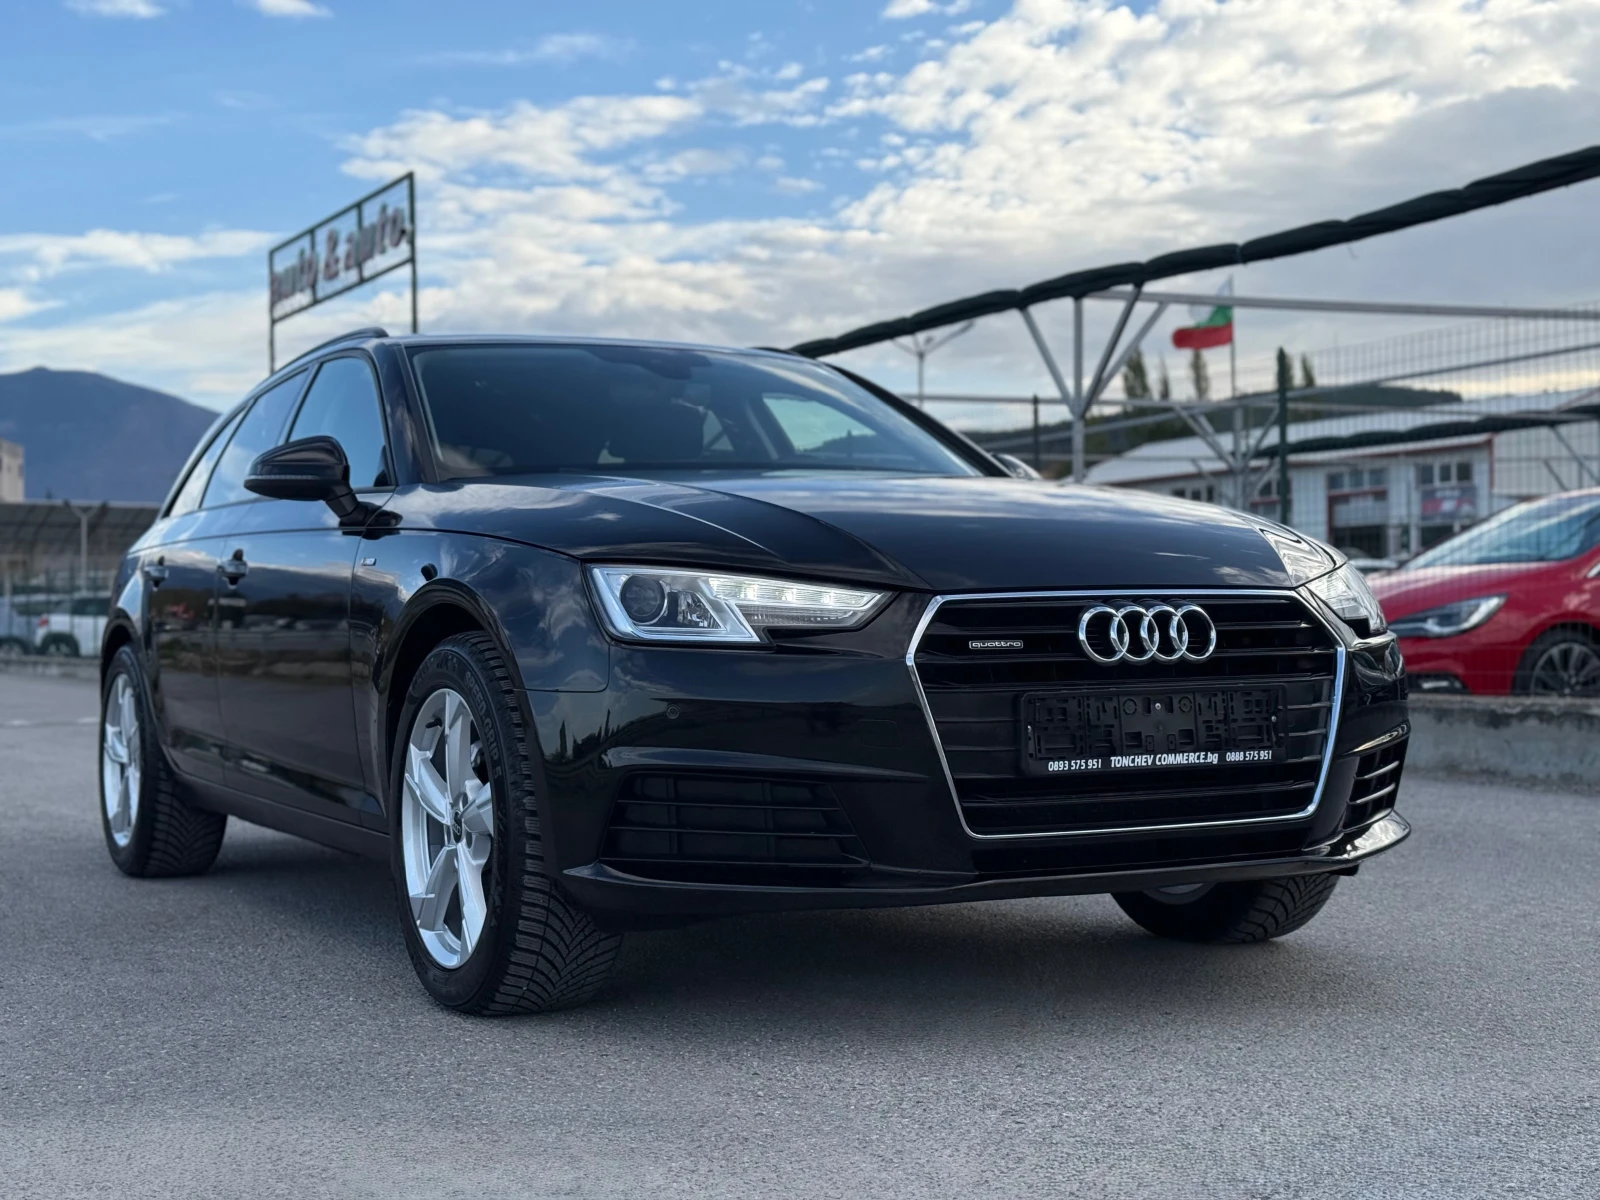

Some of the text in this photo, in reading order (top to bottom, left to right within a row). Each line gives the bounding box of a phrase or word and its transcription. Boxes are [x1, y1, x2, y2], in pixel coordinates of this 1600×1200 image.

[464, 671, 500, 760] SPEED-GRIP
[1048, 750, 1272, 771] 0893 575 951 TONCHEV COMMERCE.bg 0888 575 951
